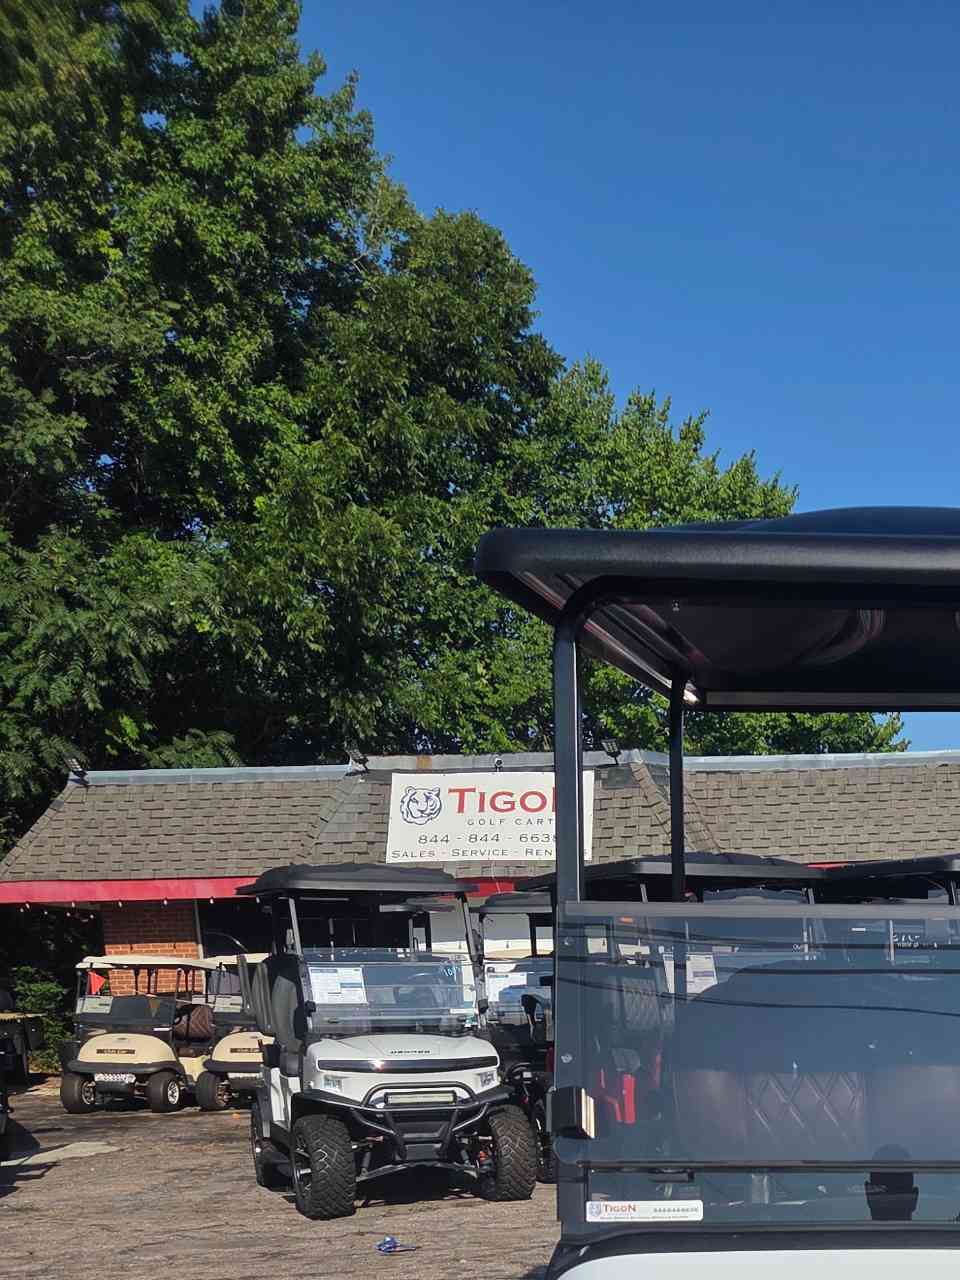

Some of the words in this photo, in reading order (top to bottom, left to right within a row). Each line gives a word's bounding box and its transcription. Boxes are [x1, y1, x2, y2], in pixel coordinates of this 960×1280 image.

[448, 787, 557, 814] TIGO
[467, 818, 506, 826] GOLF
[515, 818, 554, 826] CART
[391, 850, 436, 859] SALES
[451, 848, 509, 857] SERVICE
[525, 848, 553, 857] REN
